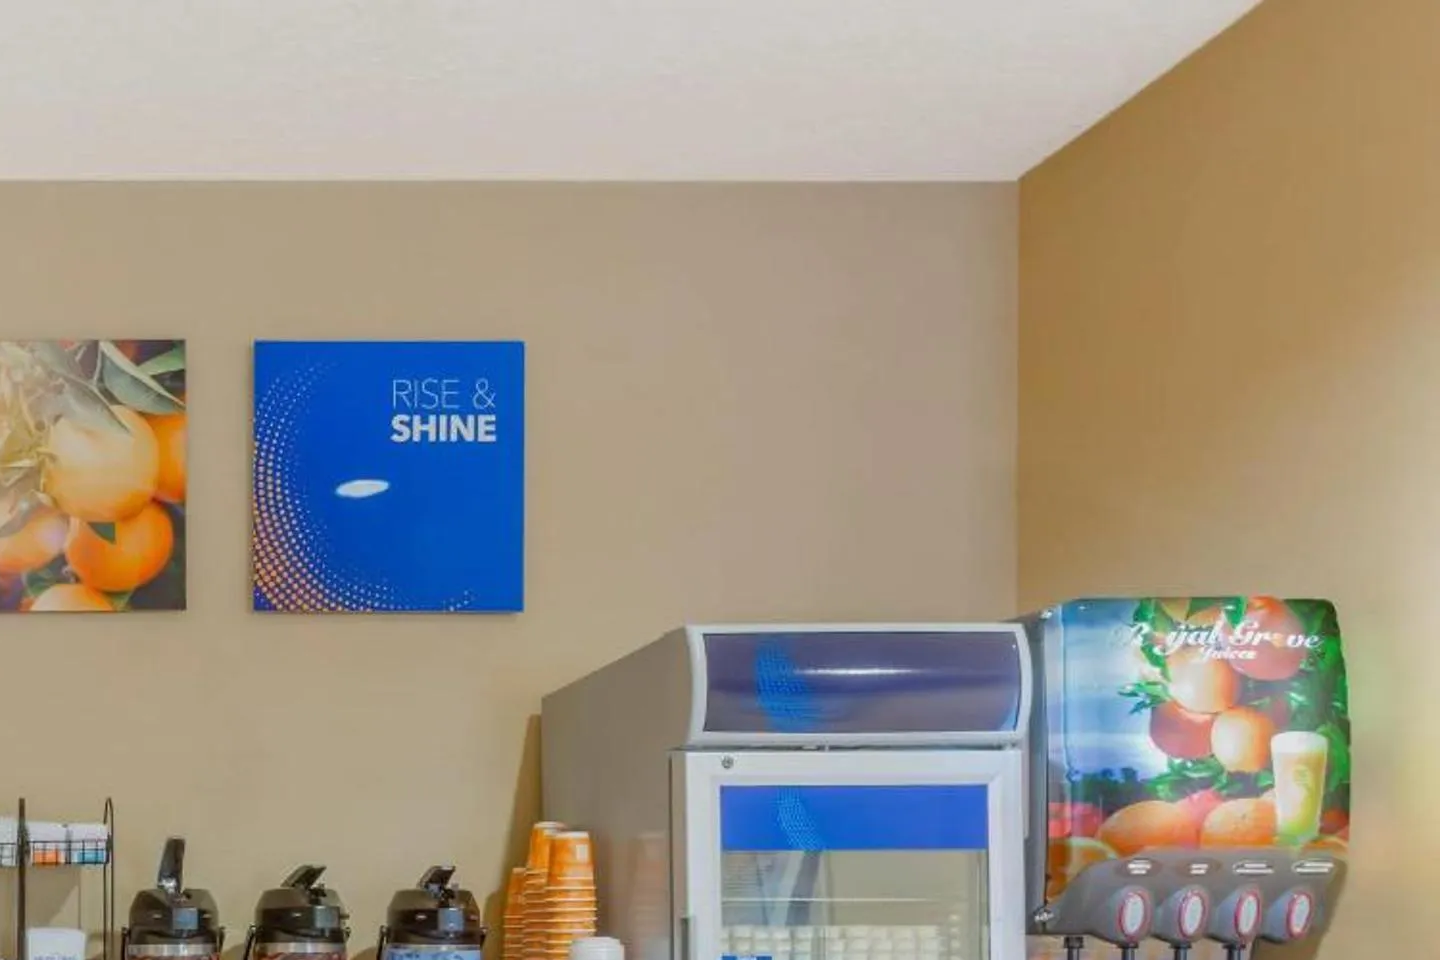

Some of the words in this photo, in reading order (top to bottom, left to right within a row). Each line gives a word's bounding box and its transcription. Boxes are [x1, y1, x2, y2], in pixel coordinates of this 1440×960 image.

[392, 379, 461, 409] RISE
[472, 378, 497, 409] &
[390, 414, 497, 443] SHINE
